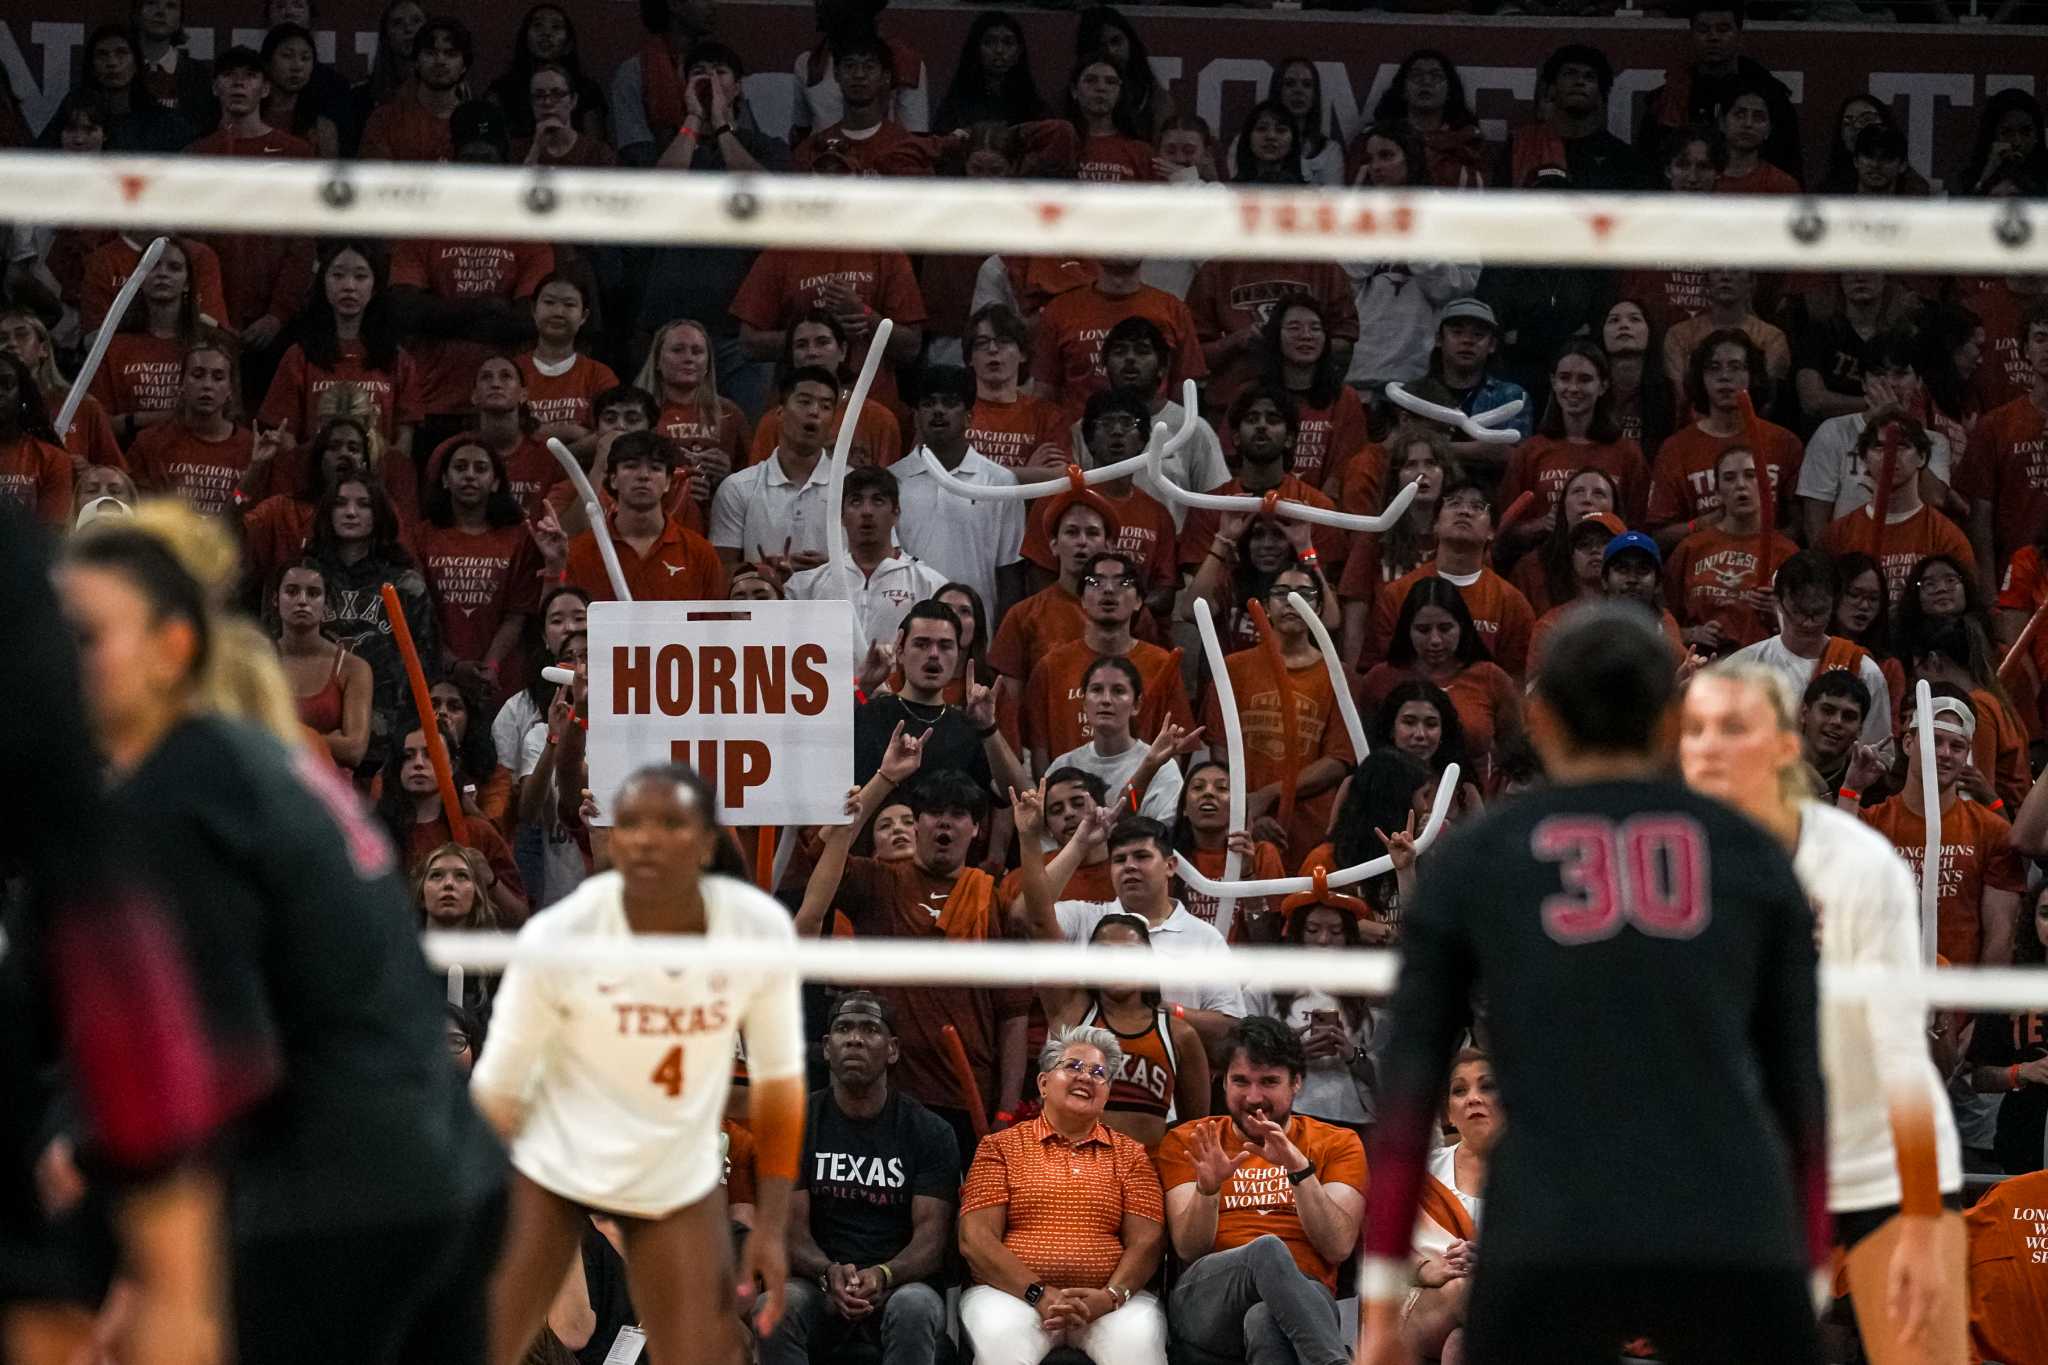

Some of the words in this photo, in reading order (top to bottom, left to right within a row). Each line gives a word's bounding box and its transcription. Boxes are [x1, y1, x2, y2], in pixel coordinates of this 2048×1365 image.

[428, 556, 512, 570] LONGHORNS
[444, 567, 493, 580] WATCH
[437, 578, 500, 593] WOMEN'S
[443, 590, 493, 605] SPORTS
[613, 643, 829, 716] HORNS
[1530, 811, 1712, 946] 30
[613, 1001, 728, 1036] TEXAS
[652, 1044, 684, 1098] 4
[815, 1152, 906, 1188] TEXAS
[1233, 1178, 1290, 1194] WATCH
[1224, 1189, 1297, 1210] WOMEN'
